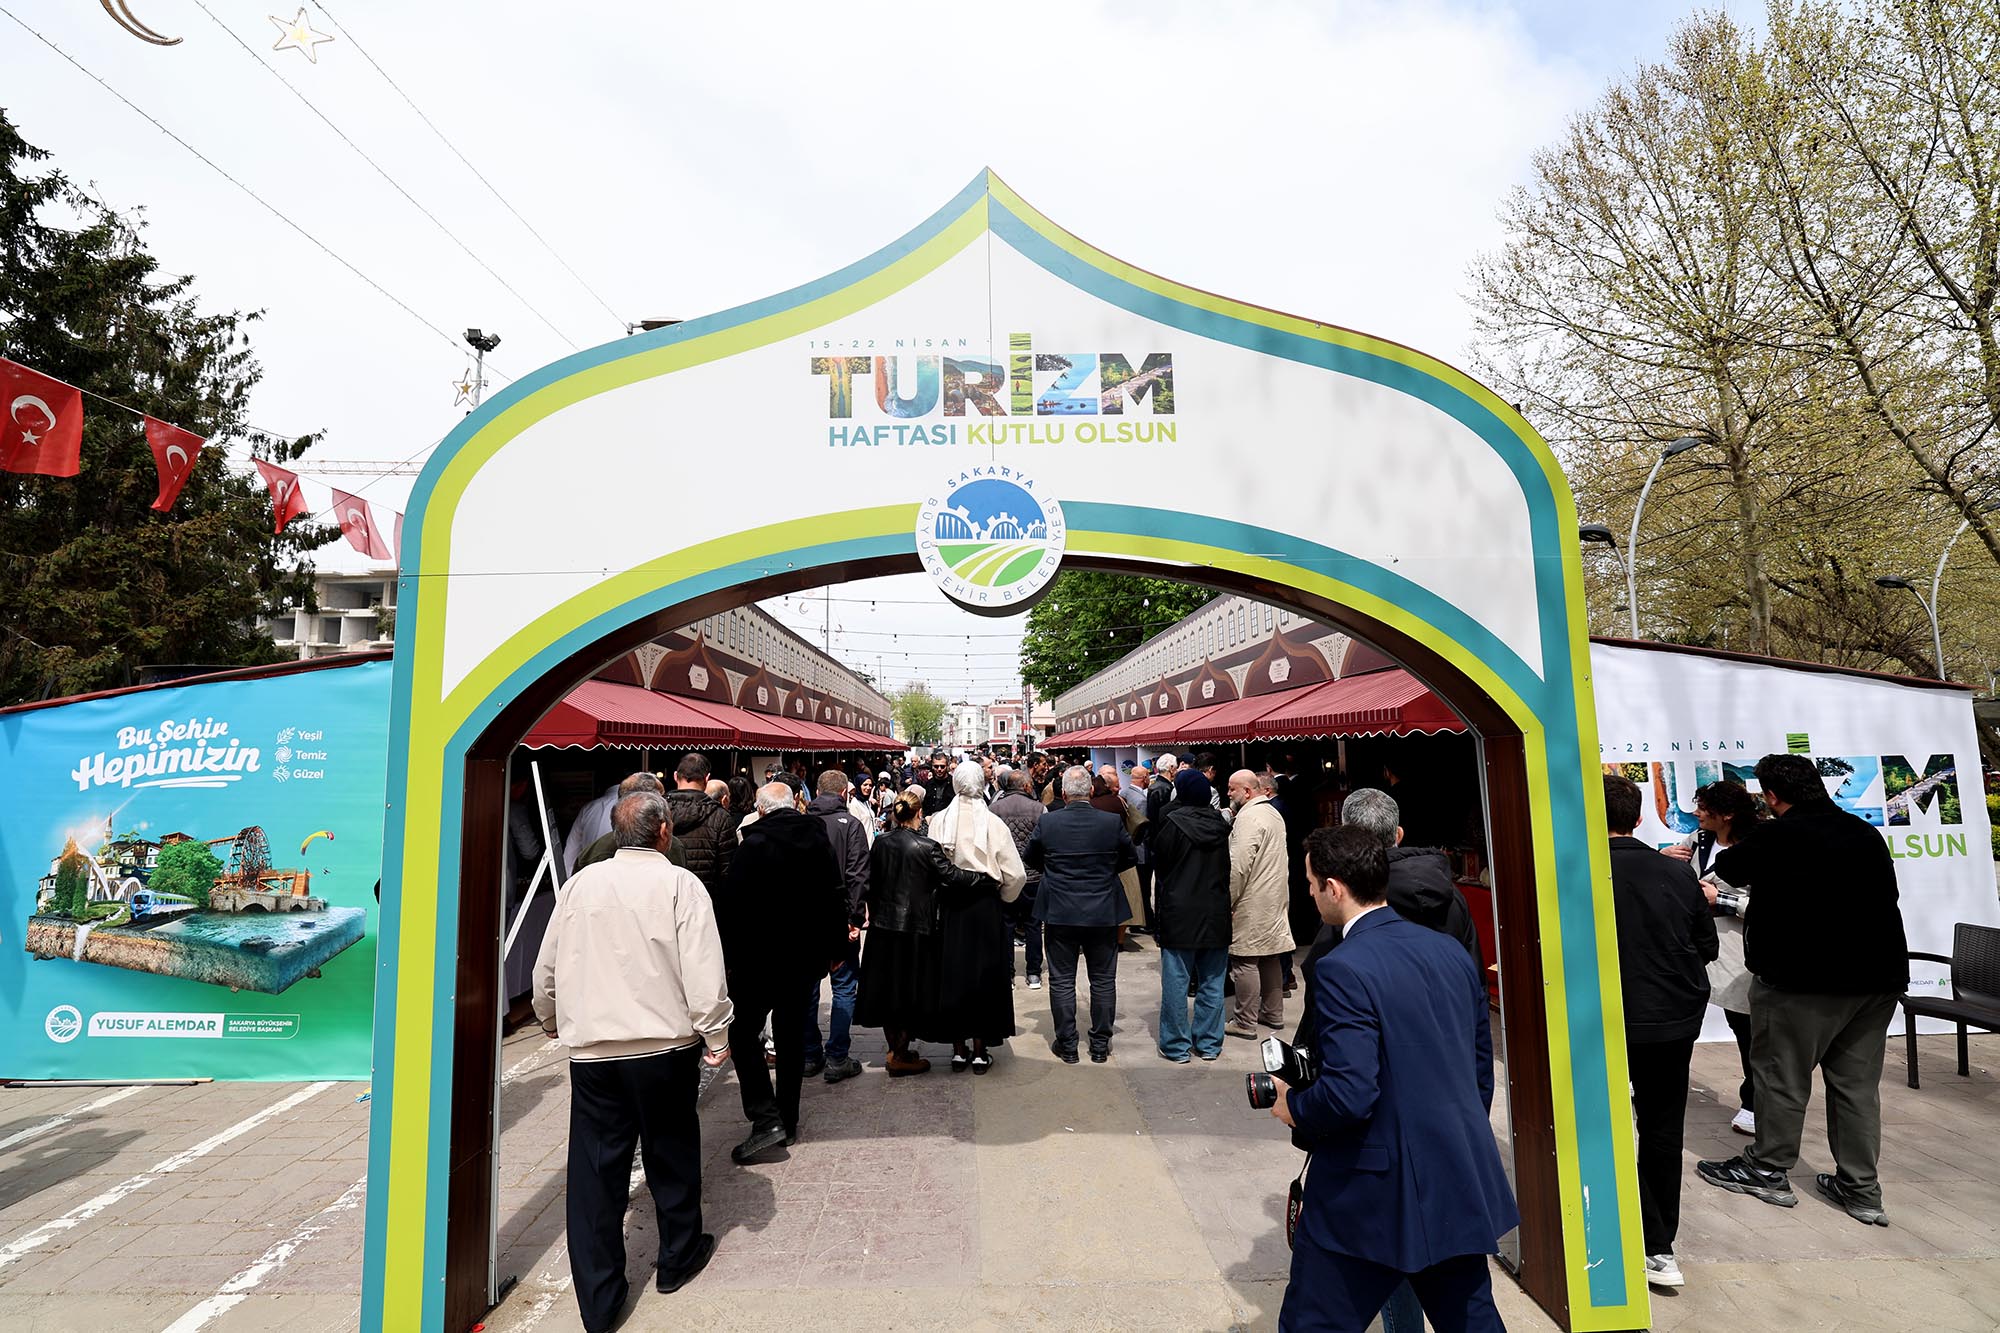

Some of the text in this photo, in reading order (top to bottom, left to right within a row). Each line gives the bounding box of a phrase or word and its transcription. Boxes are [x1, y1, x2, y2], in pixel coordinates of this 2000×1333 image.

[810, 338, 967, 348] 15-22 NİSAN
[811, 332, 1176, 419] TURİZM
[829, 421, 1177, 447] HAFTASI KUTLU OLSUN
[947, 466, 1034, 489] SAKARYA
[920, 498, 1062, 602] BÜYÜKŞEHİR BELEDİYESİ
[116, 717, 228, 749] Bu Şehir
[298, 731, 323, 742] Yeşil
[296, 749, 327, 761] Temiz
[1600, 740, 1745, 753] 5-22 NİSAN
[71, 738, 261, 792] Hepimizin
[293, 768, 324, 780] Güzel
[1888, 833, 1968, 859] LSUN
[96, 1018, 217, 1031] YUSUF ALEMDAR
